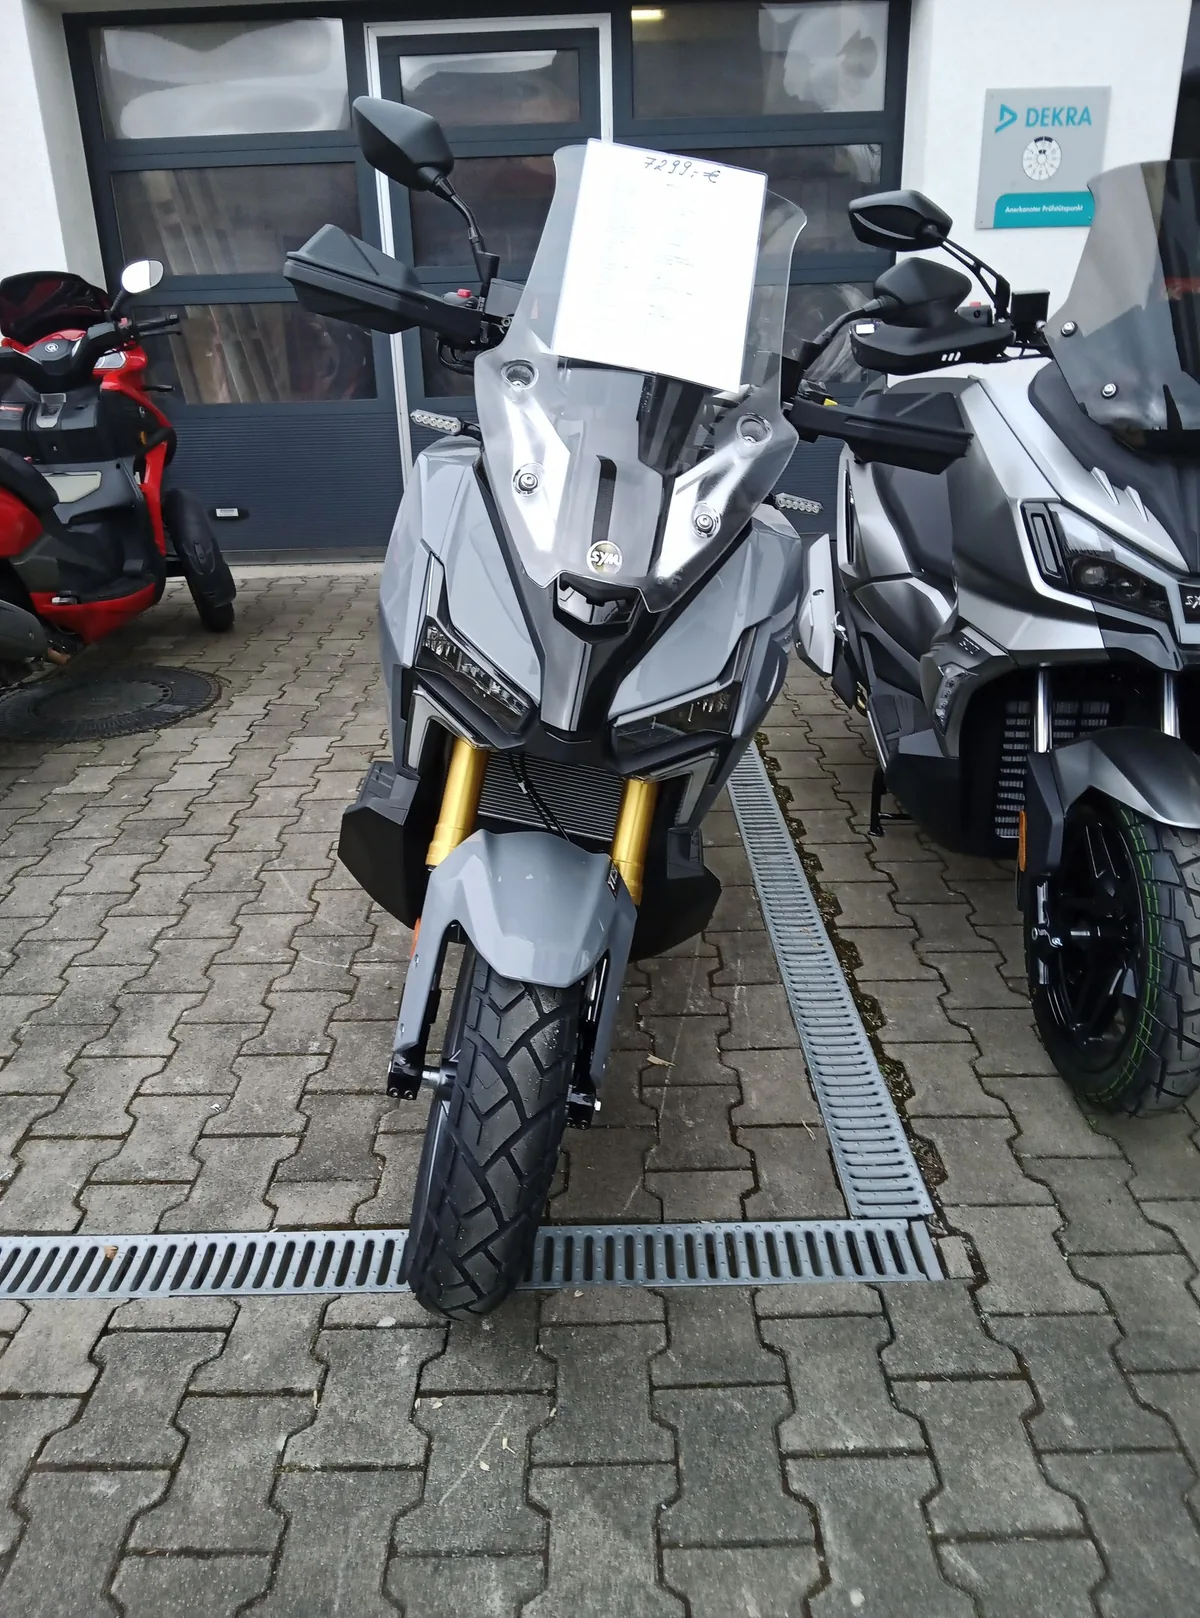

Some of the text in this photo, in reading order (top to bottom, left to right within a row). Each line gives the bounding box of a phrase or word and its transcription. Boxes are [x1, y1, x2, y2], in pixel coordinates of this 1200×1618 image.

[1025, 106, 1092, 128] DEKRA
[590, 550, 620, 566] SYM
[1185, 595, 1200, 609] SY
